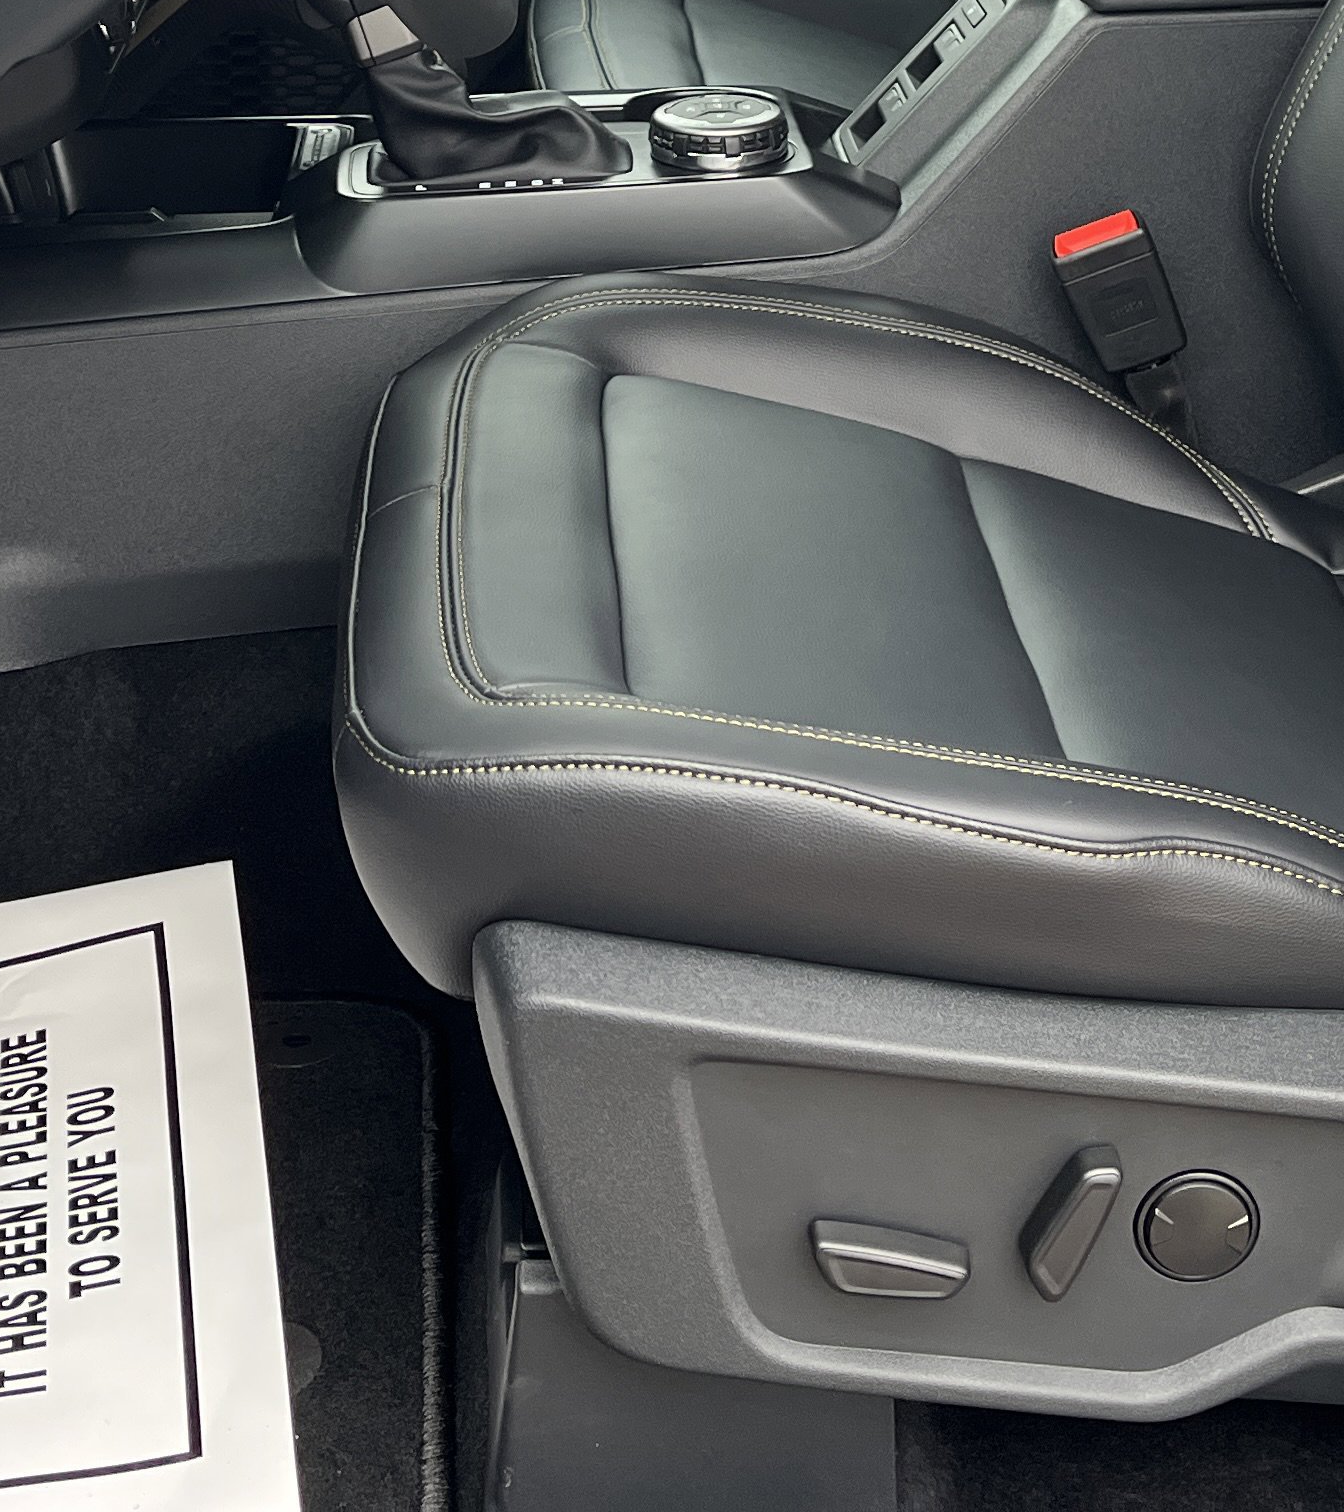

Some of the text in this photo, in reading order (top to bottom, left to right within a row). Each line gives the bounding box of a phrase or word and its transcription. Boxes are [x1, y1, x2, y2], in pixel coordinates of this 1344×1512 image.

[66, 1087, 121, 1300] TO SERVE YOU
